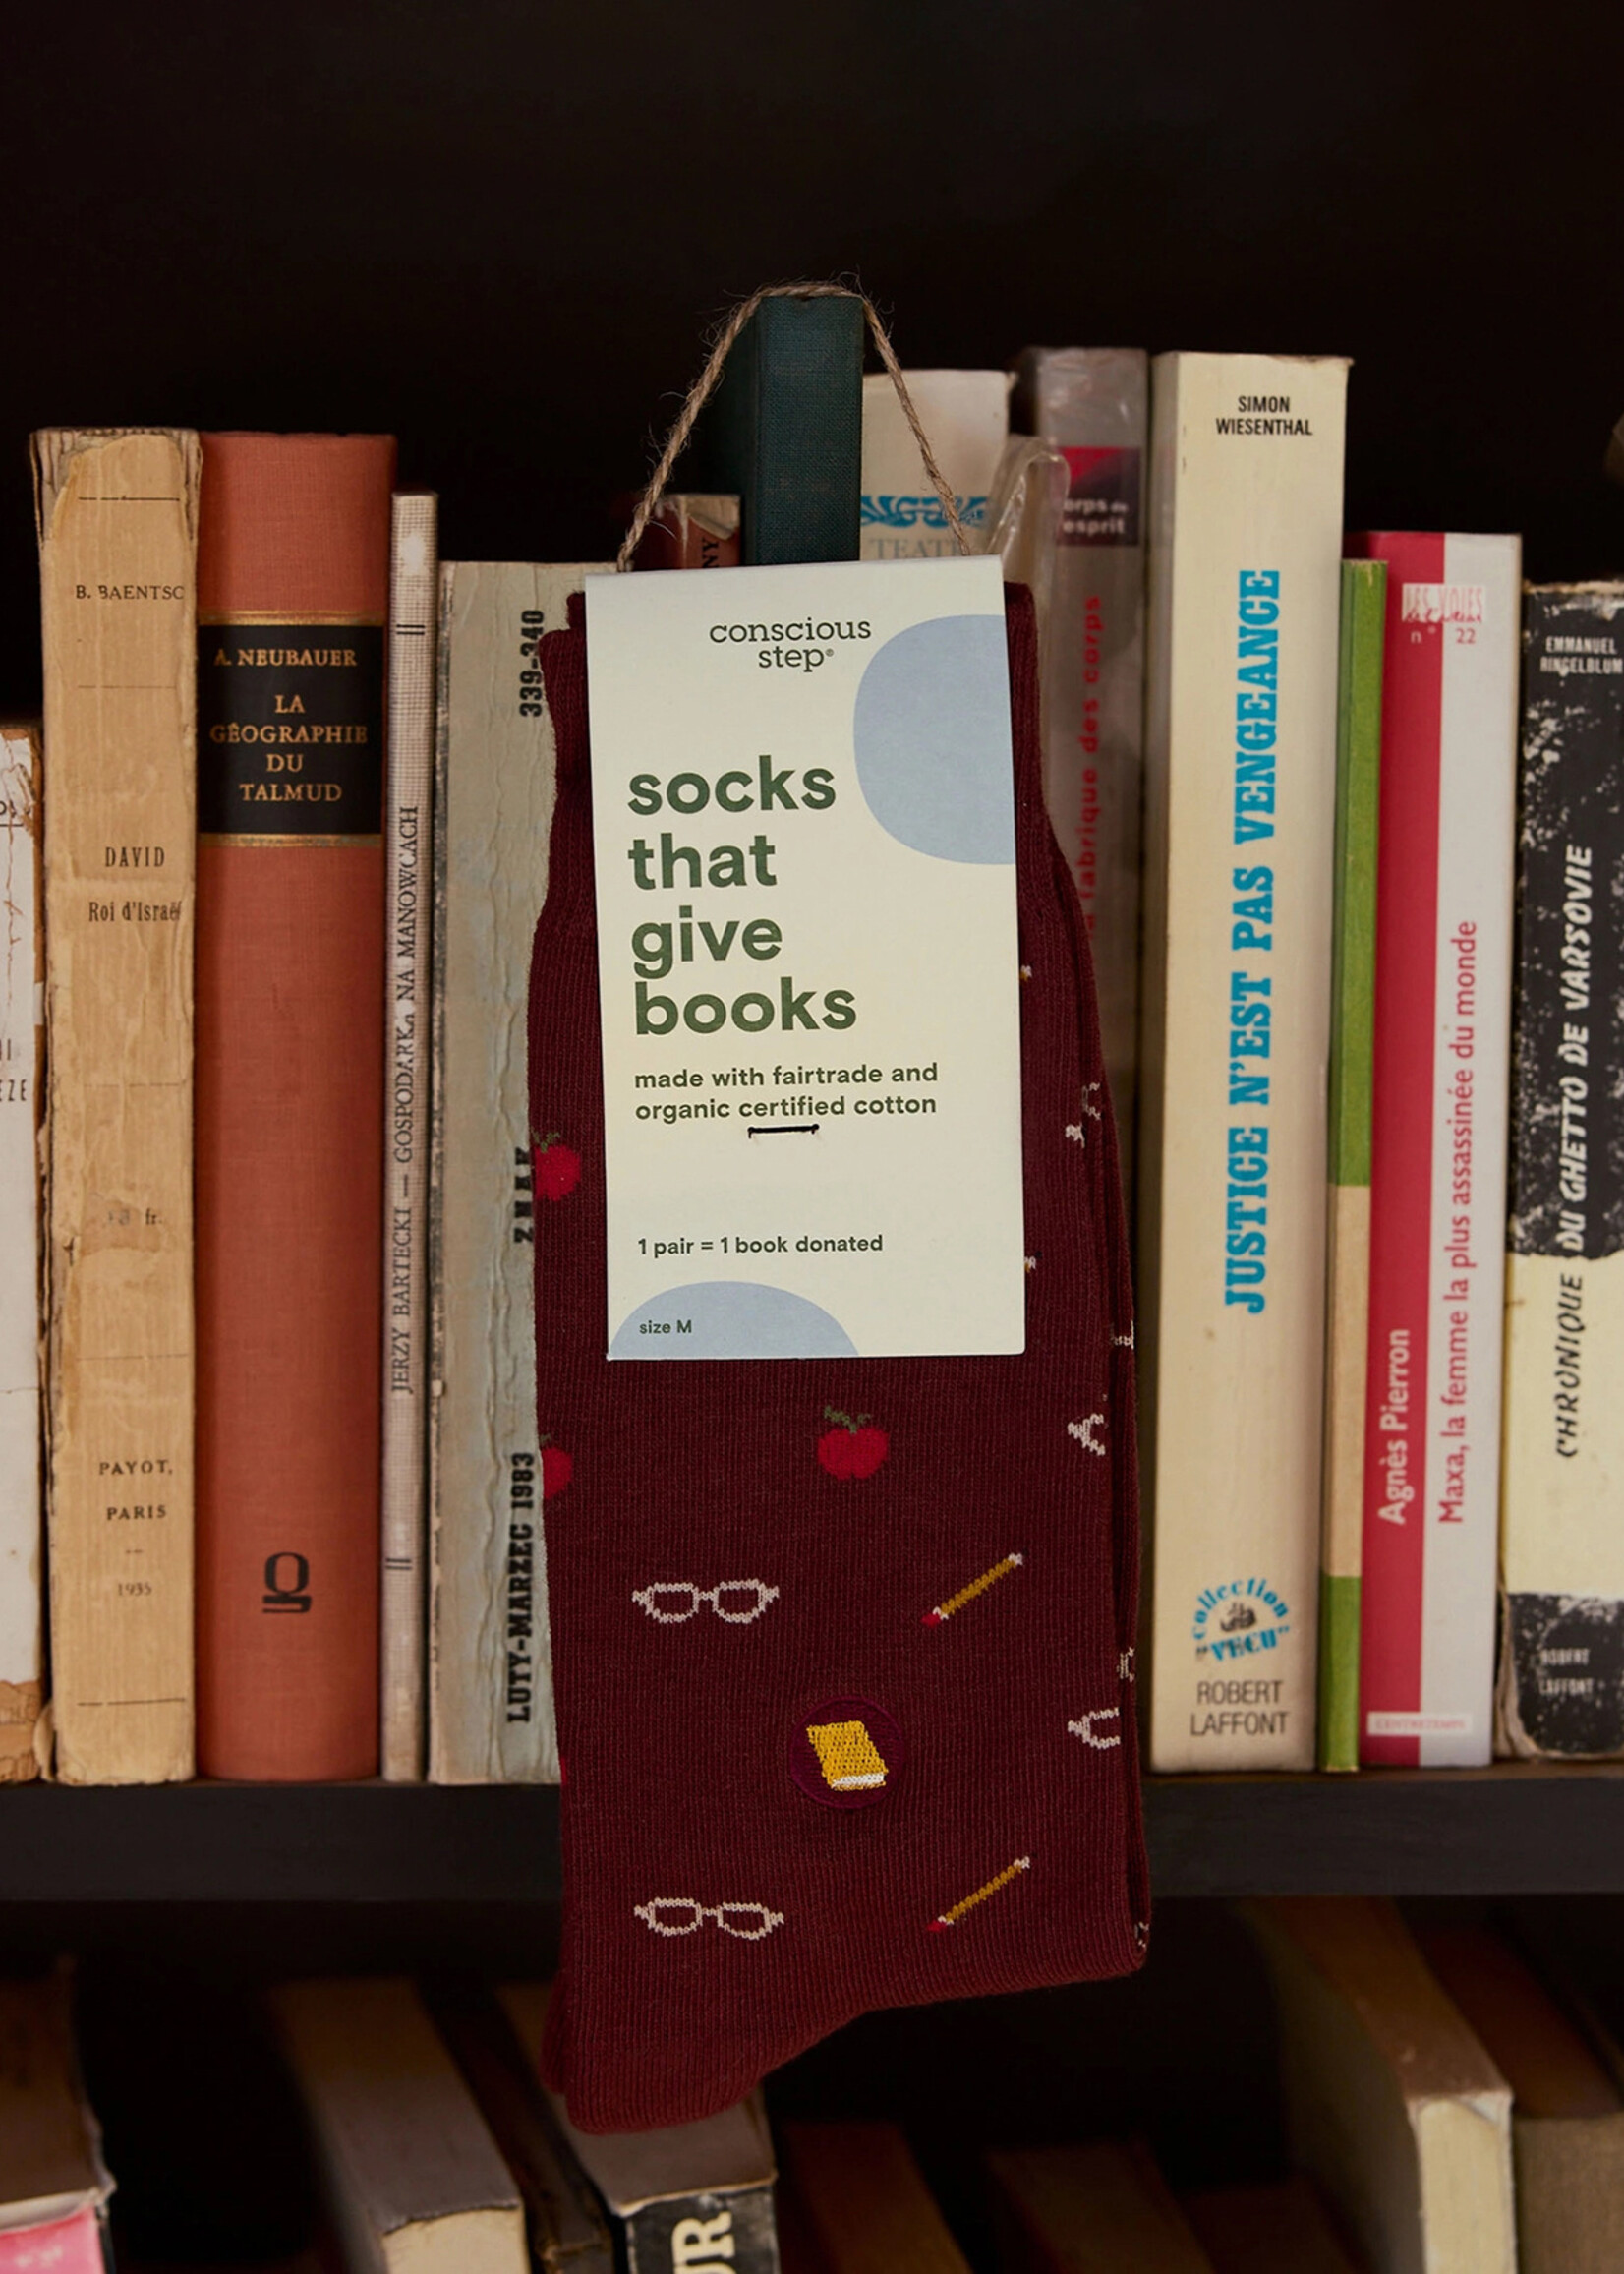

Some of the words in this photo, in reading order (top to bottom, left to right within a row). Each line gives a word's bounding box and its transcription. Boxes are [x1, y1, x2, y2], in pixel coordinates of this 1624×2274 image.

[1238, 395, 1290, 413] SIMON
[1216, 418, 1313, 436] WIESENTHAL
[76, 585, 91, 600] B.
[709, 617, 871, 644] conscious
[1083, 596, 1104, 683] corps
[1456, 627, 1476, 645] 22
[1545, 635, 1617, 655] EMMANUEL
[213, 649, 232, 667] A.
[237, 649, 357, 667] NEUBAUER
[519, 611, 544, 717] 339-340
[274, 695, 306, 714] LA
[1235, 569, 1280, 845] VENGEANCE
[1077, 699, 1099, 754] des
[266, 754, 304, 773] DU
[239, 784, 342, 802] TALMUD
[627, 755, 837, 816] socks
[104, 846, 165, 867] DAVID
[627, 833, 778, 891] that
[397, 806, 418, 959] MANOWCACH
[88, 901, 115, 922] Roi
[1232, 865, 1274, 951] PAS
[1559, 845, 1593, 1011] VARSOVIE
[631, 905, 783, 980] give
[397, 969, 415, 1001] NA
[1450, 920, 1478, 1015] monde
[634, 976, 857, 1036] books
[1229, 973, 1271, 1105] N'EST
[1448, 1026, 1474, 1058] du
[1557, 1023, 1589, 1066] DE
[0, 1079, 28, 1101] ZE
[634, 1069, 704, 1089] made
[712, 1067, 766, 1087] with
[773, 1064, 883, 1085] fairtrade
[891, 1062, 939, 1082] and
[635, 1098, 730, 1124] organic
[738, 1096, 846, 1119] certified
[853, 1097, 937, 1115] cotton
[1446, 1068, 1473, 1205] assassinée
[1559, 1078, 1588, 1201] GHETTO
[1226, 1125, 1269, 1314] JUSTICE
[1556, 1213, 1586, 1252] DU
[393, 1208, 411, 1316] BARTECKI
[638, 1239, 648, 1255] 1
[654, 1238, 695, 1258] pair
[720, 1238, 729, 1254] 1
[735, 1237, 788, 1254] book
[795, 1235, 884, 1253] donated
[1444, 1215, 1478, 1269] plus
[1443, 1276, 1470, 1302] la
[639, 1320, 671, 1335] size
[677, 1320, 692, 1334] M
[391, 1327, 414, 1394] JERZY
[1379, 1329, 1410, 1431] Pierron
[1440, 1312, 1469, 1406] femme
[1554, 1273, 1586, 1458] CHRONIQUE
[1440, 1414, 1468, 1440] la
[99, 1460, 173, 1475] PAYOT,
[511, 1452, 534, 1509] 1983
[1377, 1441, 1415, 1525] Agnès
[1437, 1445, 1471, 1524] Maxa,
[106, 1505, 166, 1520] PARIS
[507, 1523, 533, 1723] LUTY-MARZEC
[1196, 1680, 1283, 1705] ROBERT
[1190, 1711, 1290, 1736] LAFFONT
